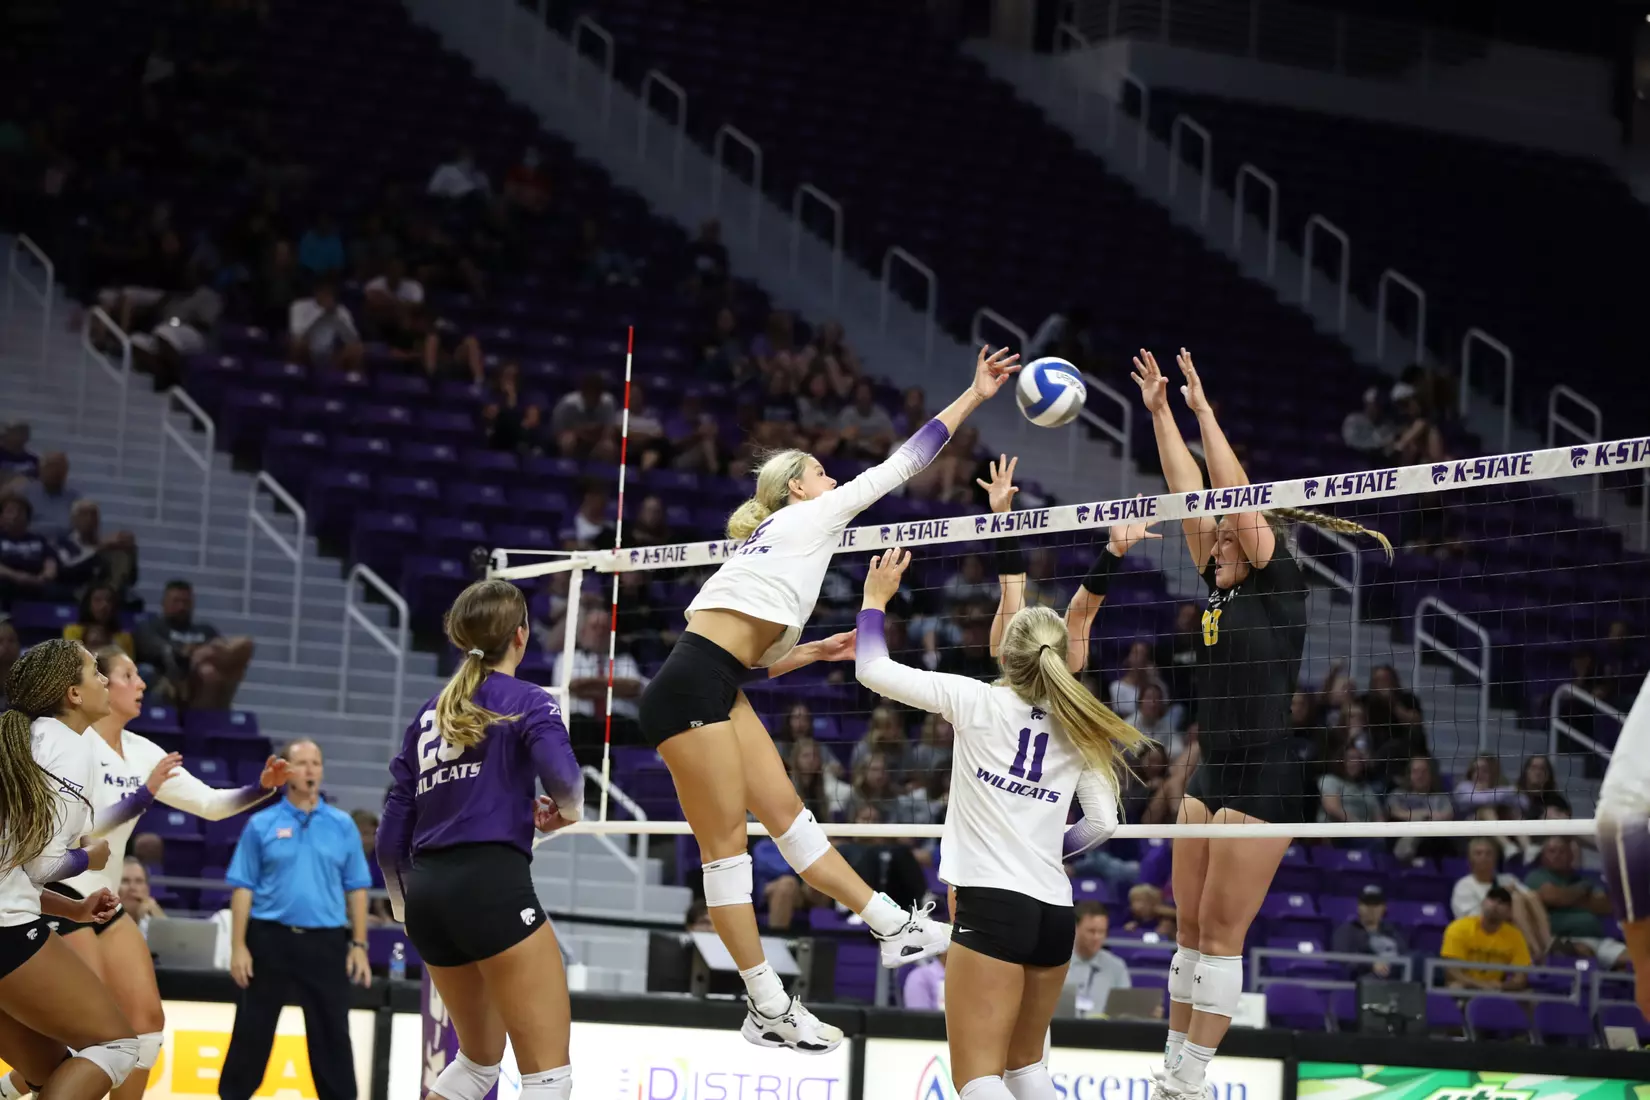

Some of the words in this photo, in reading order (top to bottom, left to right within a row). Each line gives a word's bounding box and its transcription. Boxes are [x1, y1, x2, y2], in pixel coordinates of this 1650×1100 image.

[895, 519, 950, 543] K-STATE
[990, 509, 1050, 533] K-STATE
[1093, 497, 1158, 523] K-STATE
[1204, 483, 1273, 511] K-STATE
[1324, 469, 1399, 499] K-STATE
[1453, 453, 1534, 484] K-STATE
[1008, 727, 1050, 783] 11
[103, 773, 142, 789] K-STATE
[976, 767, 1062, 804] WILDCATS
